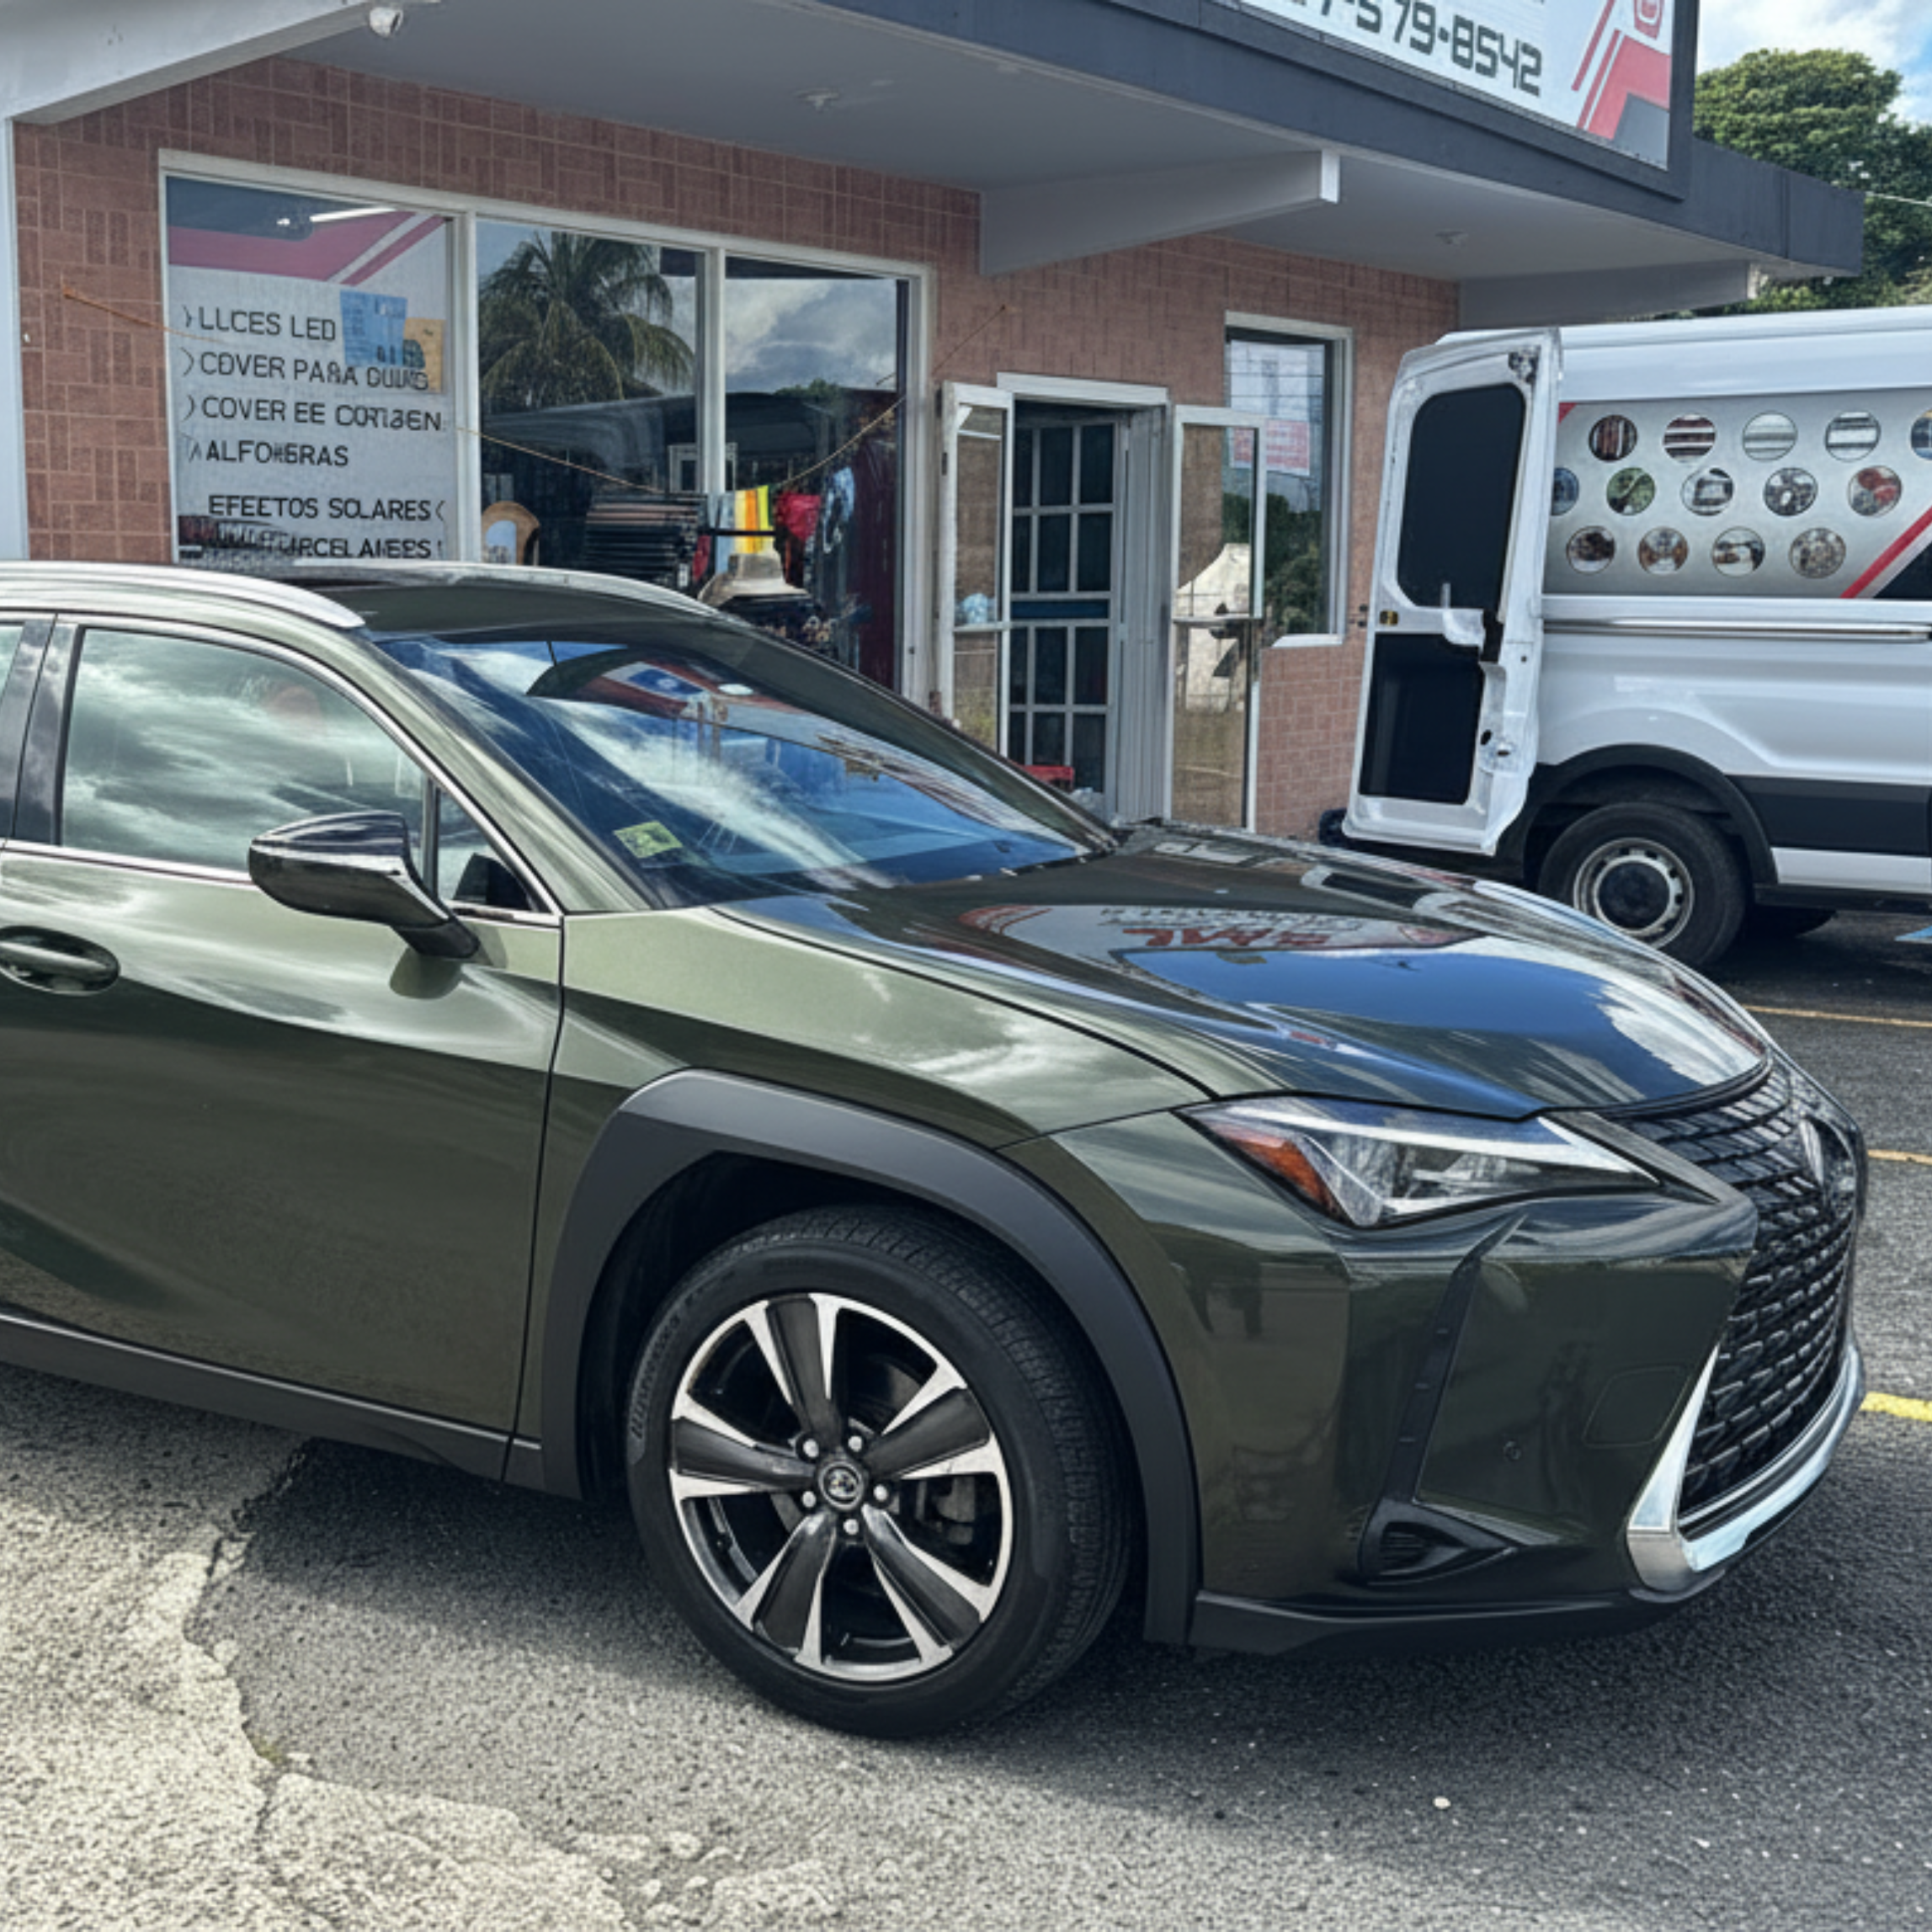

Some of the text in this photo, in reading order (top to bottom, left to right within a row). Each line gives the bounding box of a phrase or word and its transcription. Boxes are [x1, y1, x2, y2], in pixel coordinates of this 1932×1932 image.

[291, 313, 336, 342] LED
[201, 394, 285, 422] COVER
[328, 498, 431, 521] SOLARES
